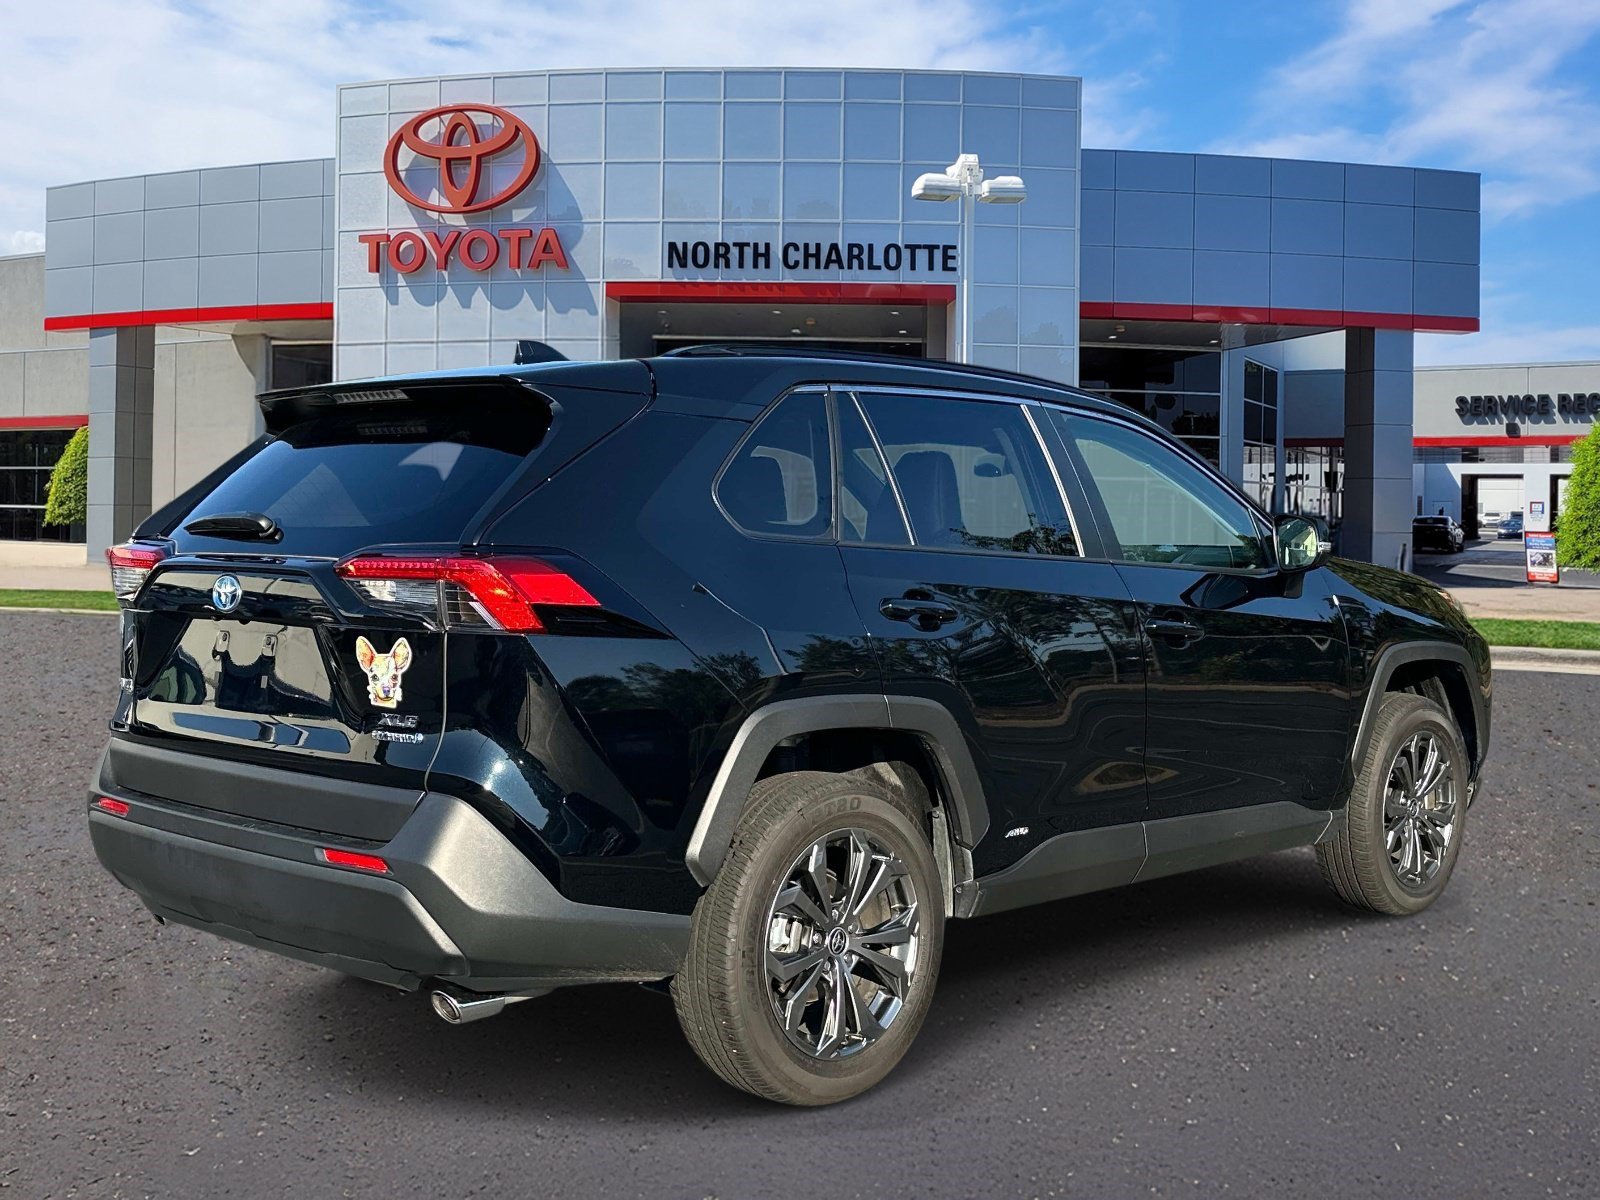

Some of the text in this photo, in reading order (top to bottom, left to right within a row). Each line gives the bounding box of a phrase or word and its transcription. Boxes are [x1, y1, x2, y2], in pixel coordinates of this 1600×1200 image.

[358, 227, 570, 274] TOYOTA
[667, 241, 958, 272] NORTH CHARLOTTE
[1455, 394, 1551, 417] SERVICE
[378, 712, 418, 728] XLE
